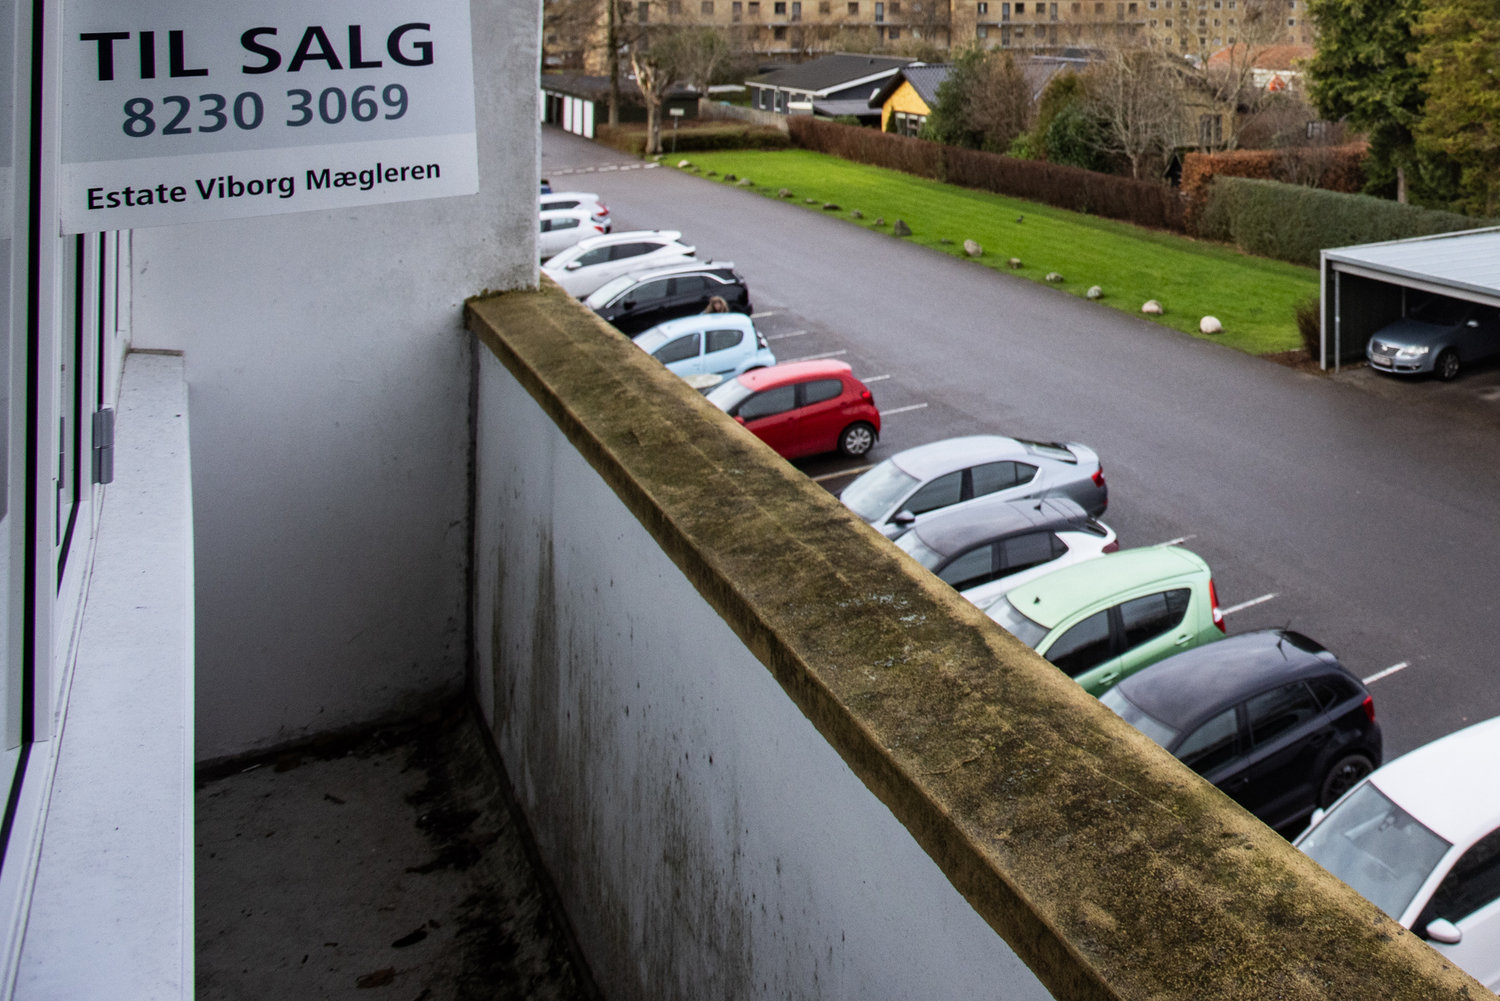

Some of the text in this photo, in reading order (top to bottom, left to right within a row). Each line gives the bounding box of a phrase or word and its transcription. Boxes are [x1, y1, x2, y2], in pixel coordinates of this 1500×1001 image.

[80, 22, 434, 82] TIL SALG
[122, 83, 409, 138] 8230 3069
[87, 162, 441, 211] Estate Viborg Mægleren
